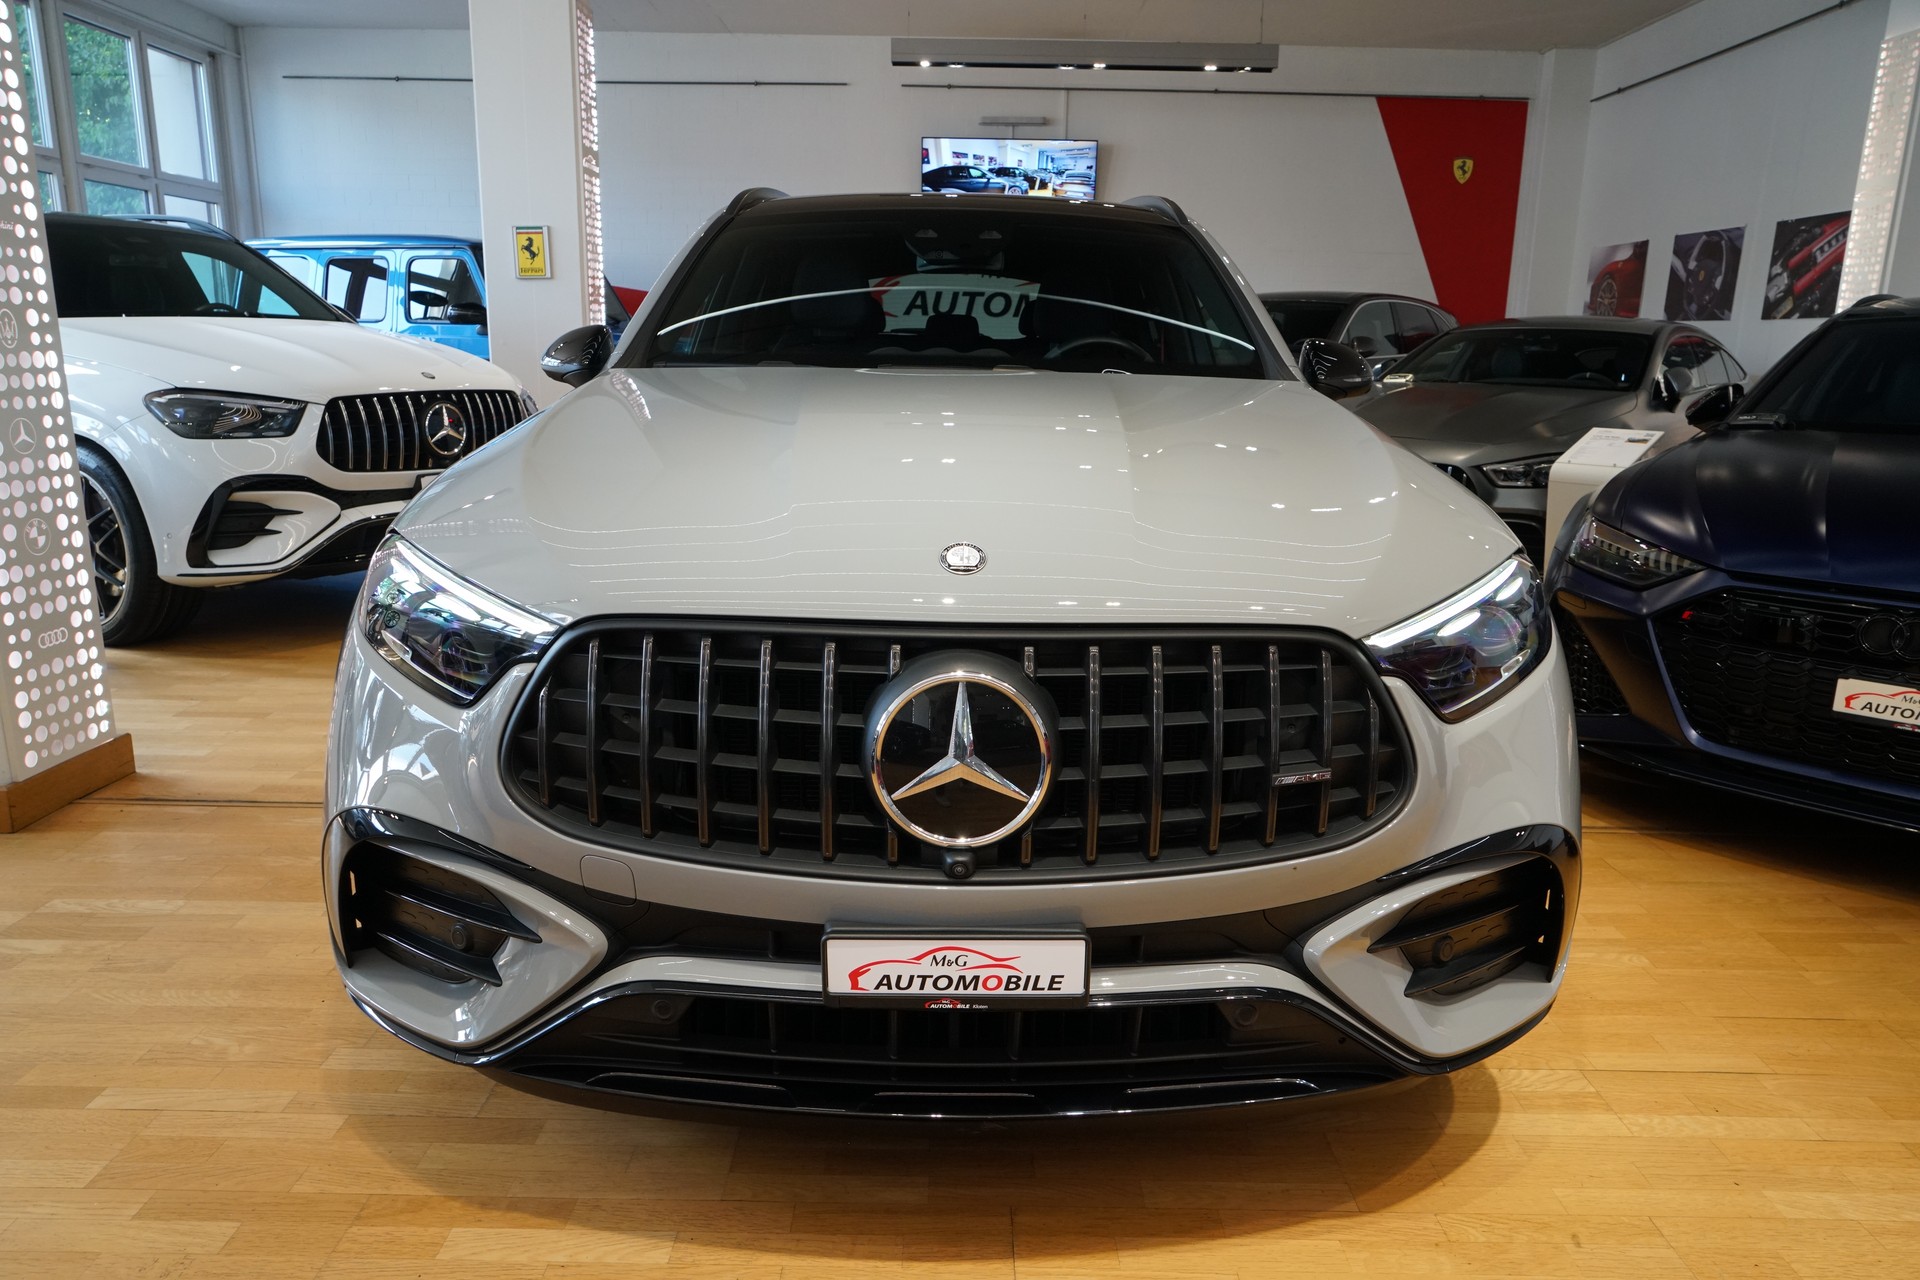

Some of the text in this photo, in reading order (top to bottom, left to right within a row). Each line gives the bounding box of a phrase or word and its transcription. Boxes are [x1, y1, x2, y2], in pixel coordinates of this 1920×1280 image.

[1292, 771, 1332, 784] AMG
[929, 954, 969, 968] M&G
[873, 974, 1065, 992] AUTOMOBILE
